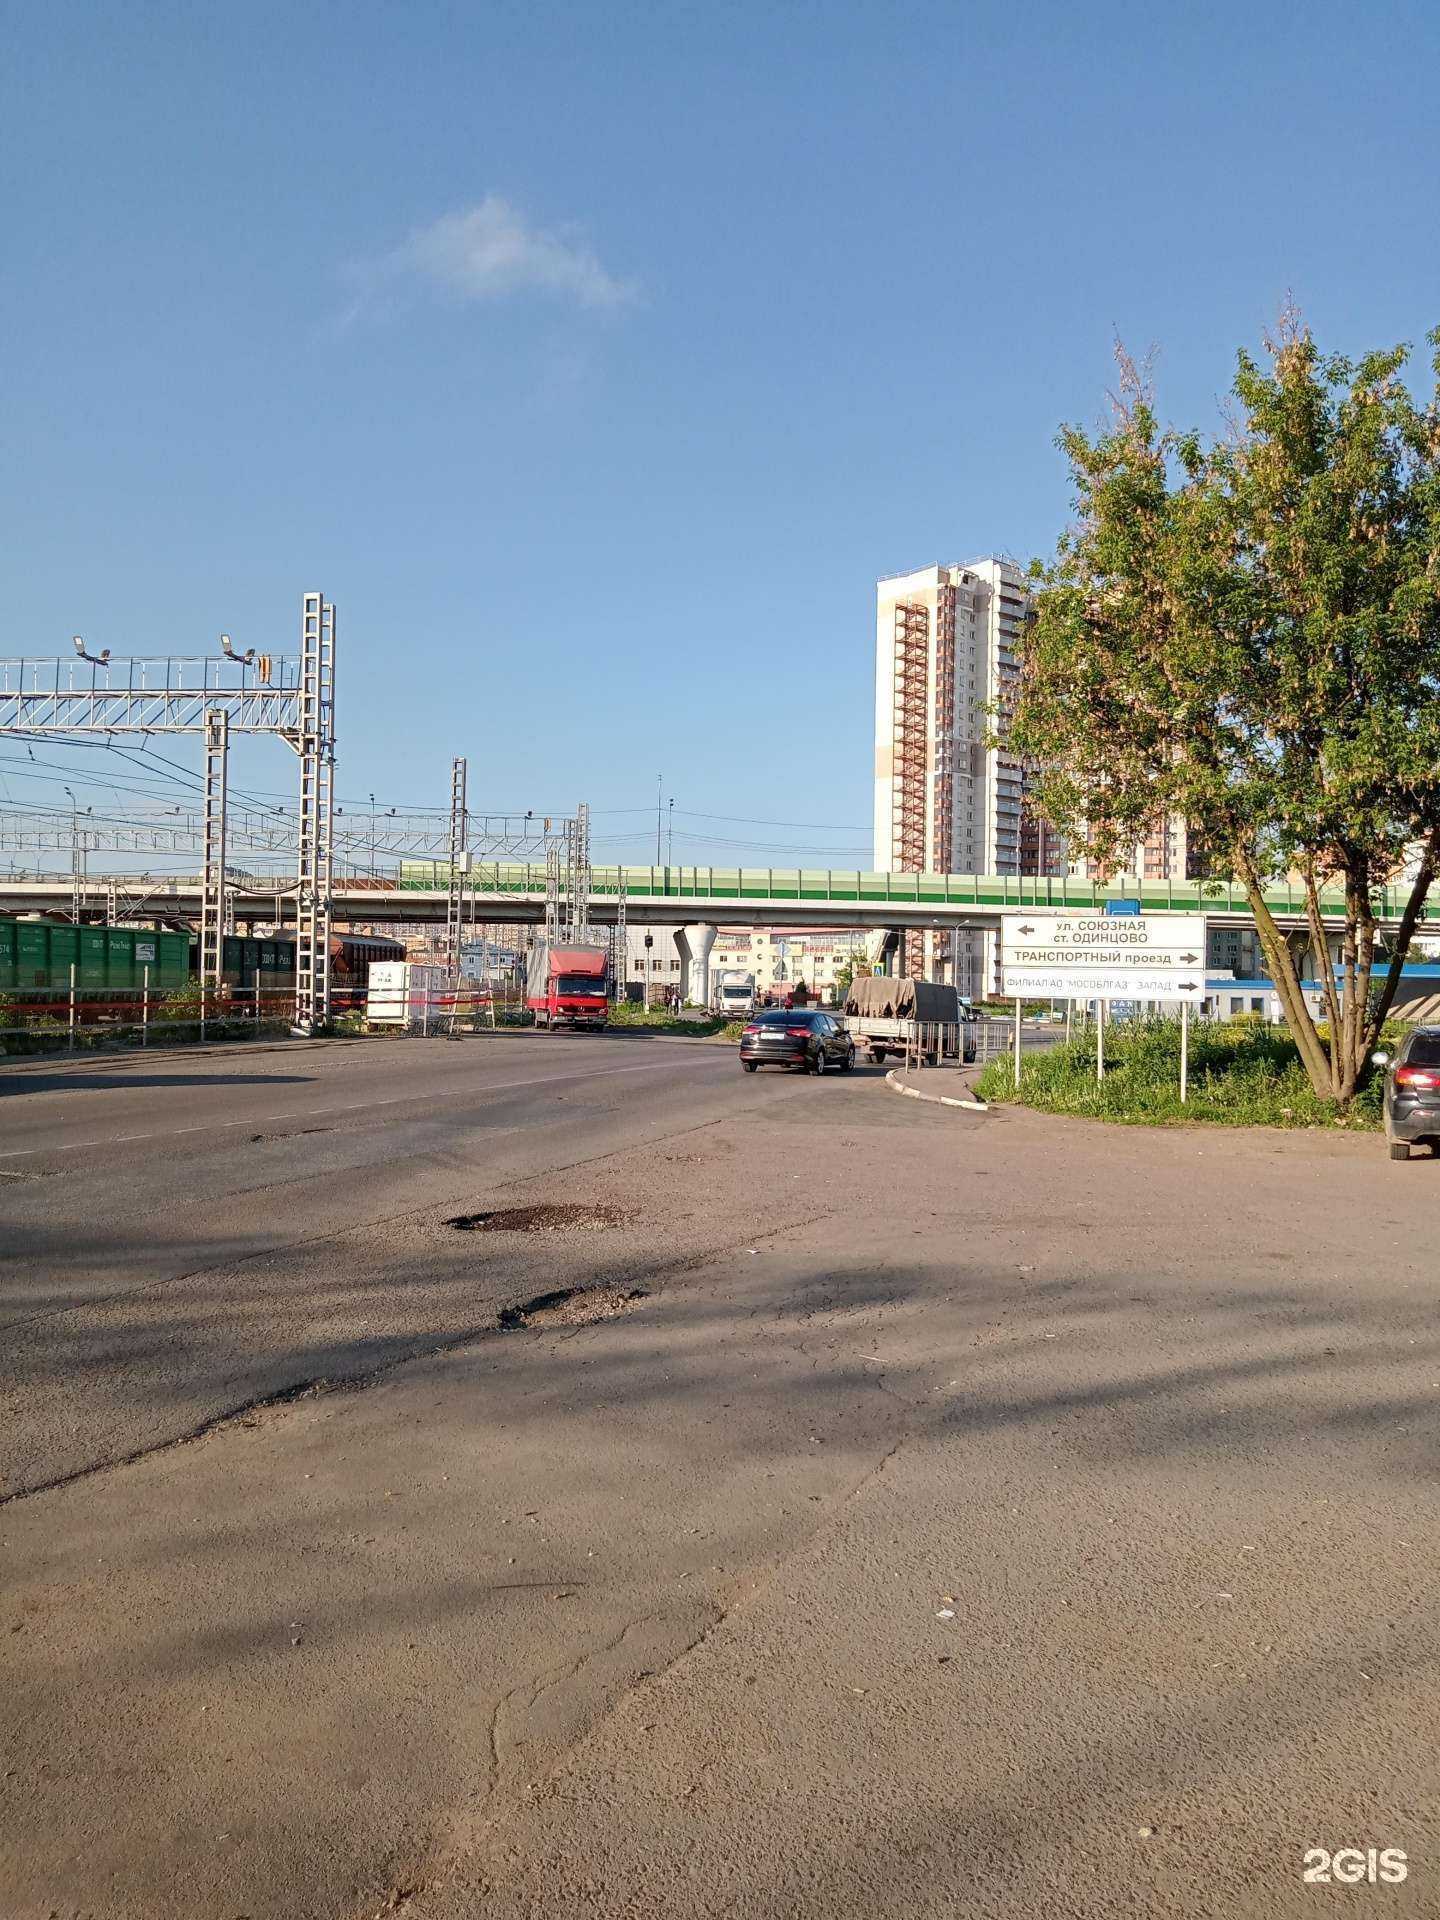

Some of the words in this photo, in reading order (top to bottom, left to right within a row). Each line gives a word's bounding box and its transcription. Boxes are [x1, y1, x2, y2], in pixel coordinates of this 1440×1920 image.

[1078, 921, 1146, 931] СОЮЗНАЯ
[1053, 935, 1069, 943] ст.
[1072, 933, 1148, 944] ОДИНЦОВО
[1014, 950, 1121, 962] ТРАНСПОРТНЫЙ
[1125, 954, 1172, 964] проезд
[1006, 978, 1048, 987] ФИЛИАЛ
